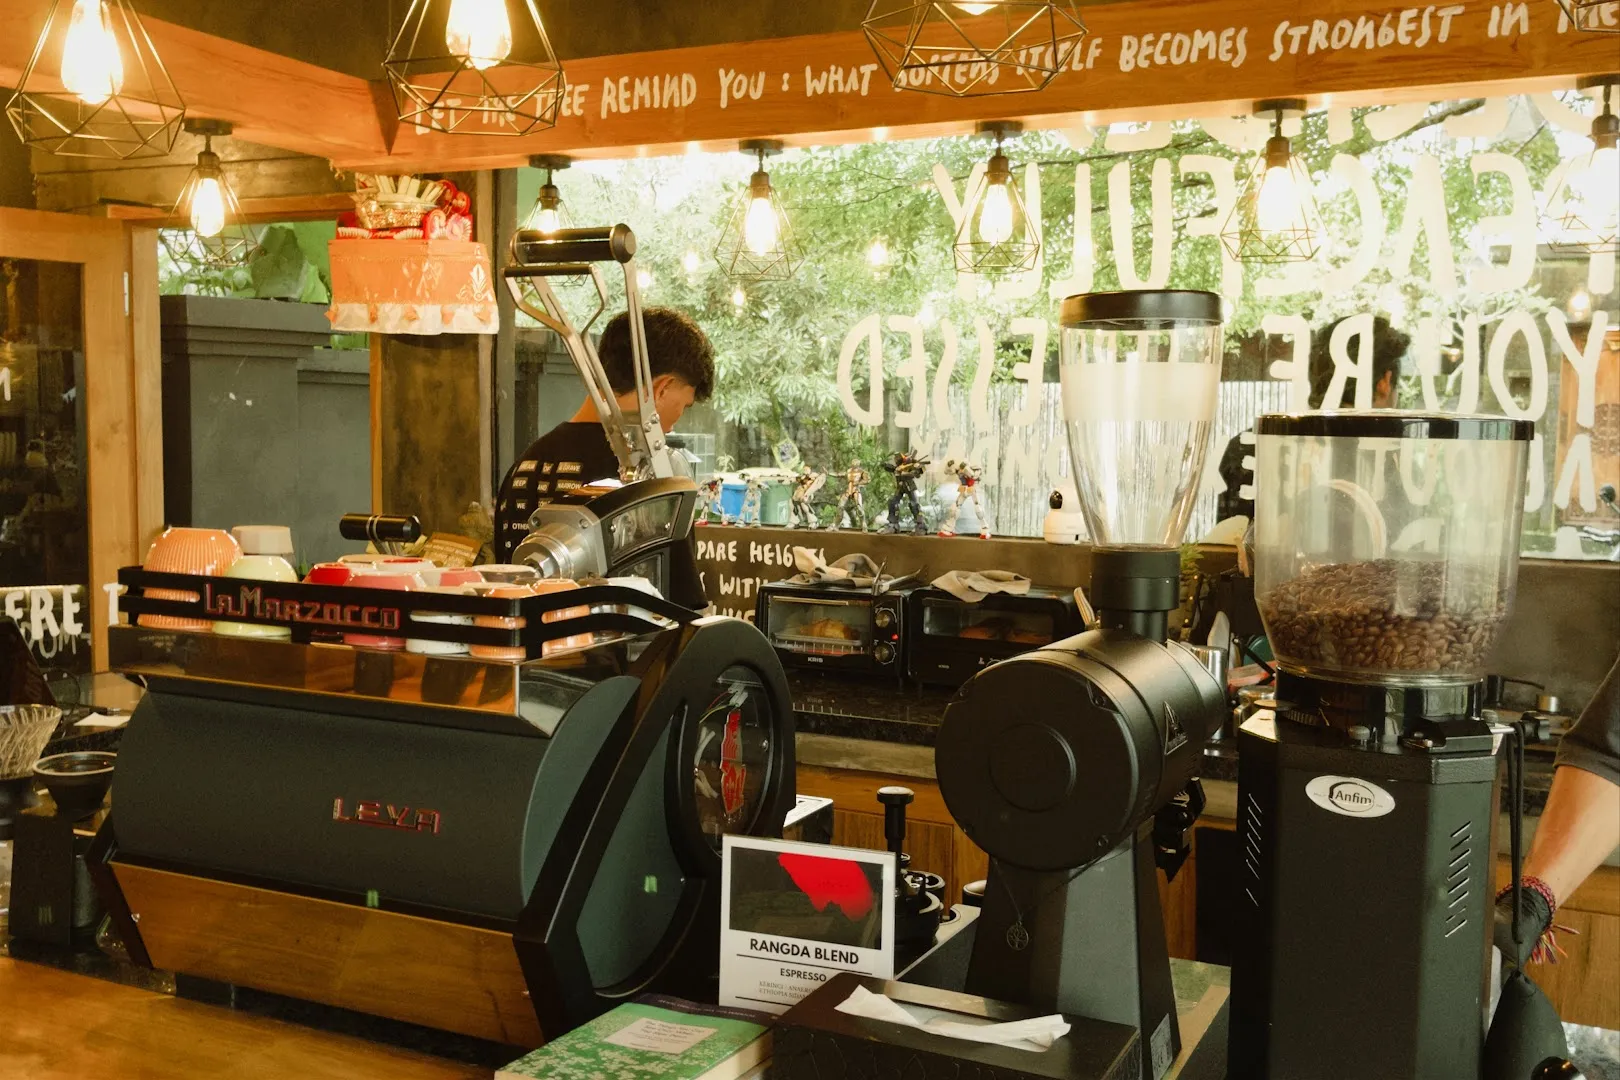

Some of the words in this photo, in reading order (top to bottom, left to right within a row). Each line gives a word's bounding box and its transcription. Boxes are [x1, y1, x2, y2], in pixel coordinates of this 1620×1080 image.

[600, 72, 697, 119] REMIND
[718, 68, 765, 108] YOU
[805, 63, 878, 97] WHAT
[1016, 37, 1103, 76] ITSELF
[1119, 26, 1248, 72] BECOMES
[1269, 5, 1465, 61] STRONGEST
[1487, 2, 1529, 38] IN
[749, 541, 827, 568] HEIGS
[1335, 790, 1372, 804] Anfim
[750, 938, 811, 958] RANGDA
[814, 947, 859, 965] BLEND
[780, 968, 827, 982] ESPRESSO
